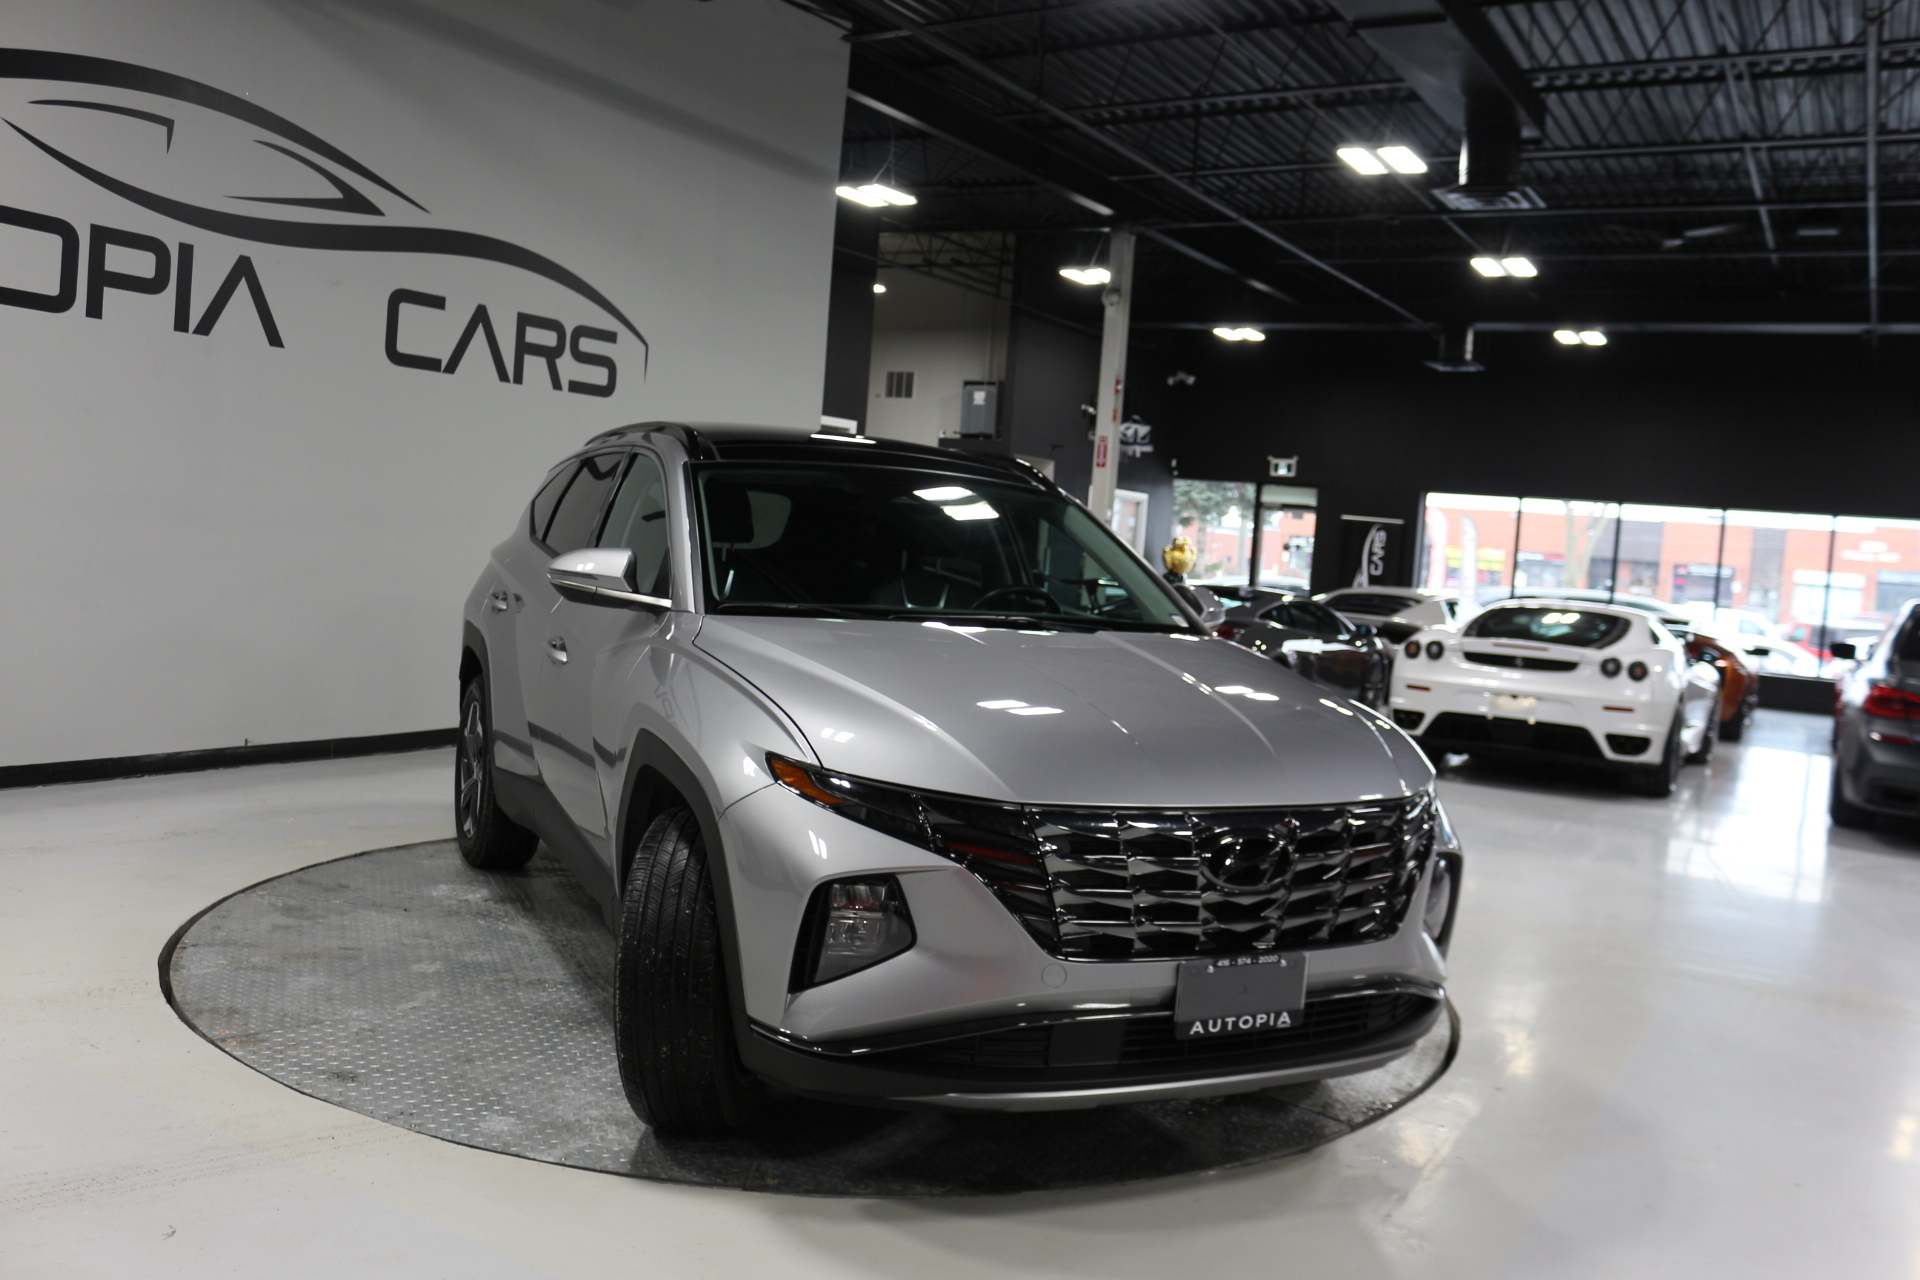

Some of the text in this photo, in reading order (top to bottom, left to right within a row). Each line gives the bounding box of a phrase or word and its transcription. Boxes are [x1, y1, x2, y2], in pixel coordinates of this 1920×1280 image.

[384, 288, 618, 398] CARS
[1369, 530, 1387, 576] CARS
[1189, 1011, 1291, 1035] AUTOPIA
